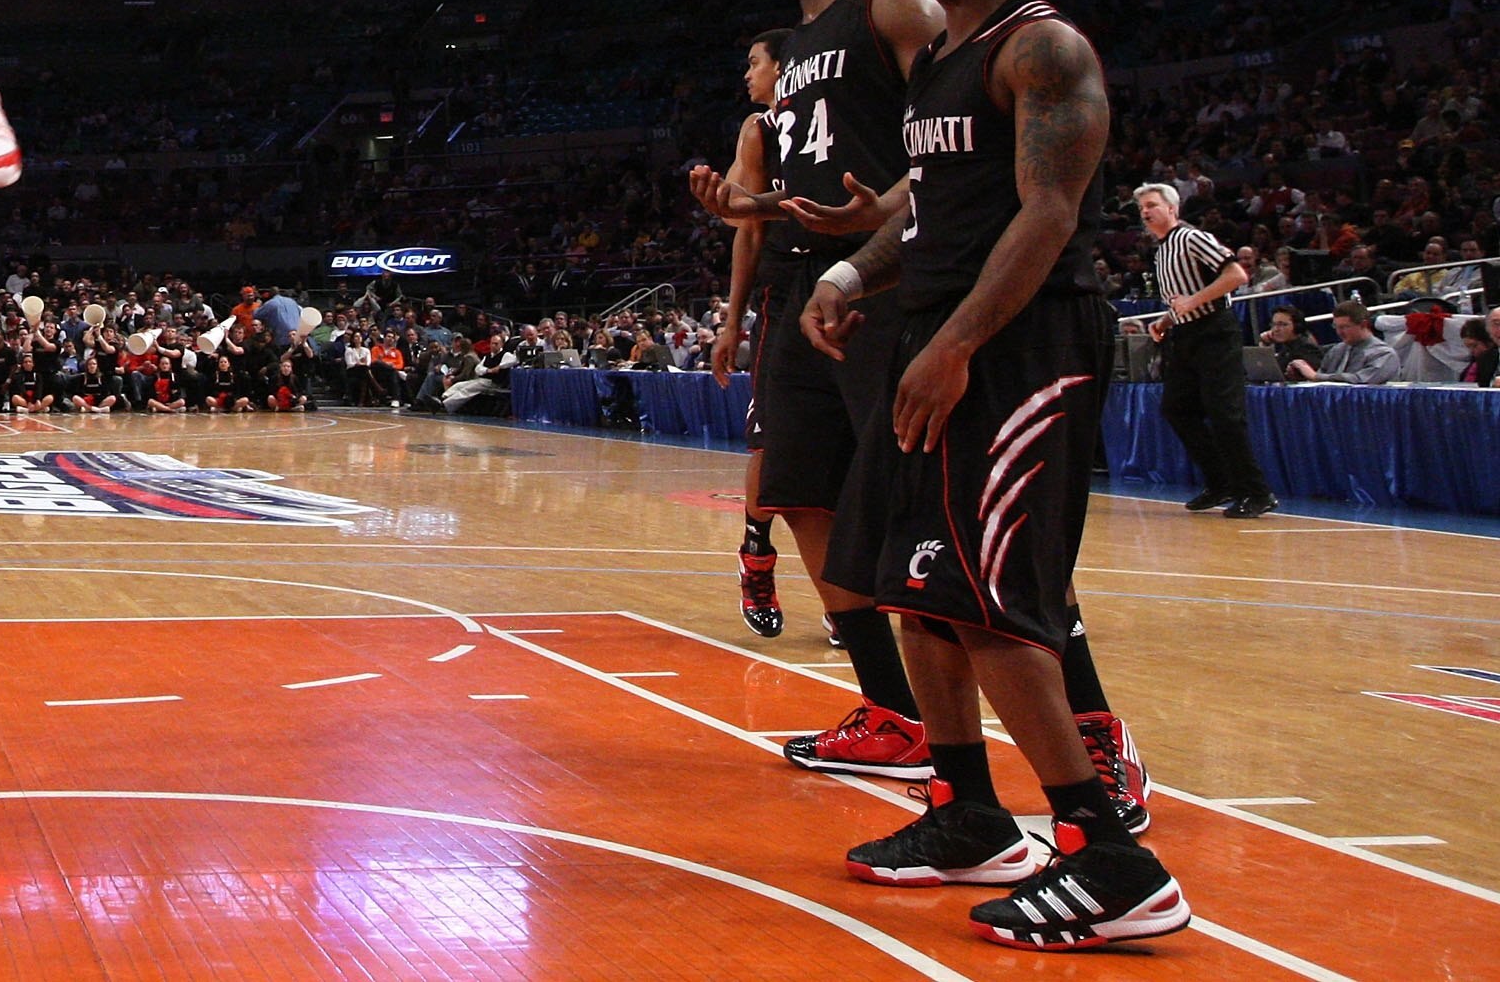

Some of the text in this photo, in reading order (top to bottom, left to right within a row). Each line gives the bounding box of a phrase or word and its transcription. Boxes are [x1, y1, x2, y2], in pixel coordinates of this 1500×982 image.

[778, 97, 835, 166] 34
[902, 114, 974, 159] CINNATI
[331, 254, 452, 268] BUD LIGHT
